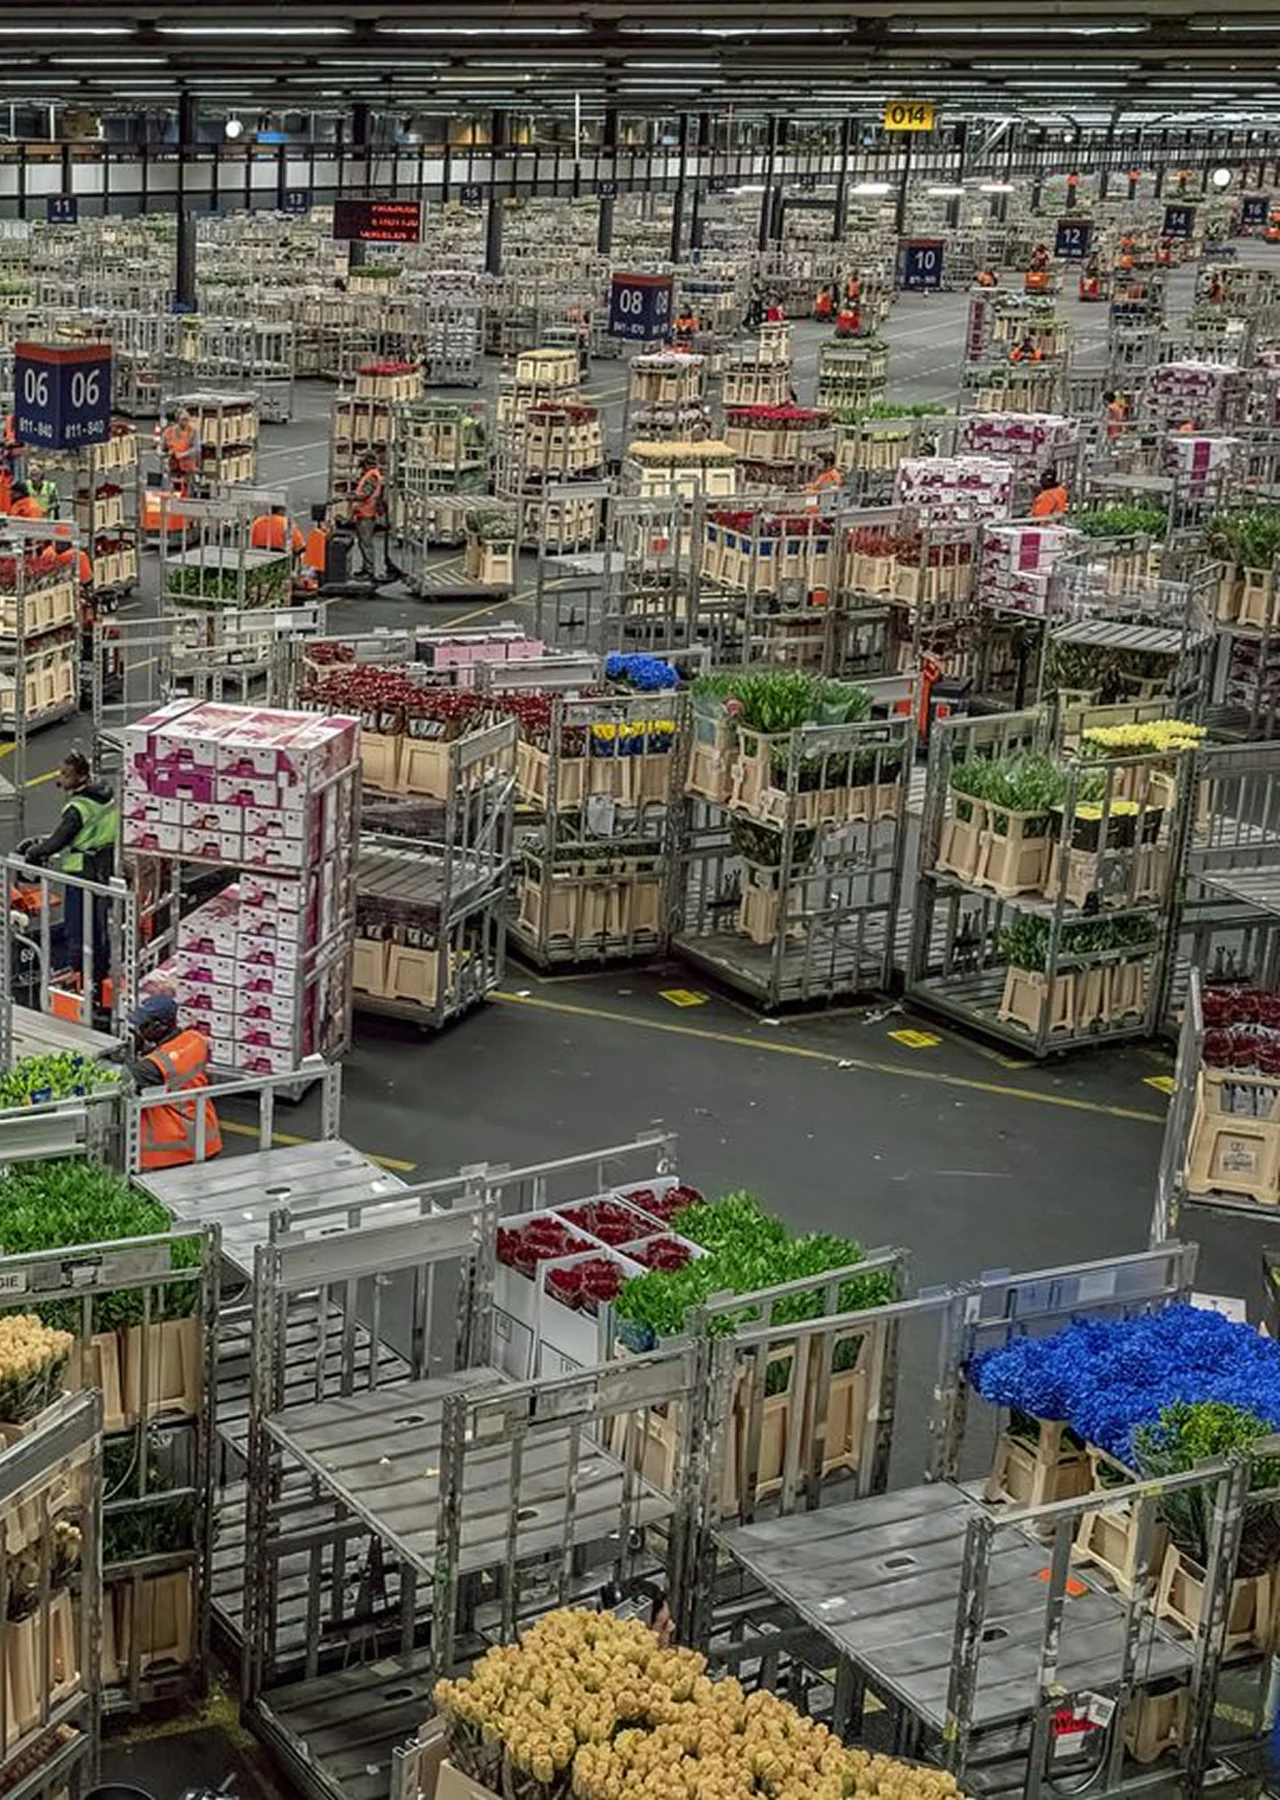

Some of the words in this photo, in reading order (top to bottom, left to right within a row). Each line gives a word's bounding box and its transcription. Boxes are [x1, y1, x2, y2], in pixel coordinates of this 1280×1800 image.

[54, 200, 70, 213] 11
[1172, 212, 1185, 225] 14
[1064, 228, 1081, 244] 12
[915, 251, 936, 270] 10
[620, 289, 643, 315] 08
[24, 368, 49, 407] 06
[71, 369, 100, 408] 06
